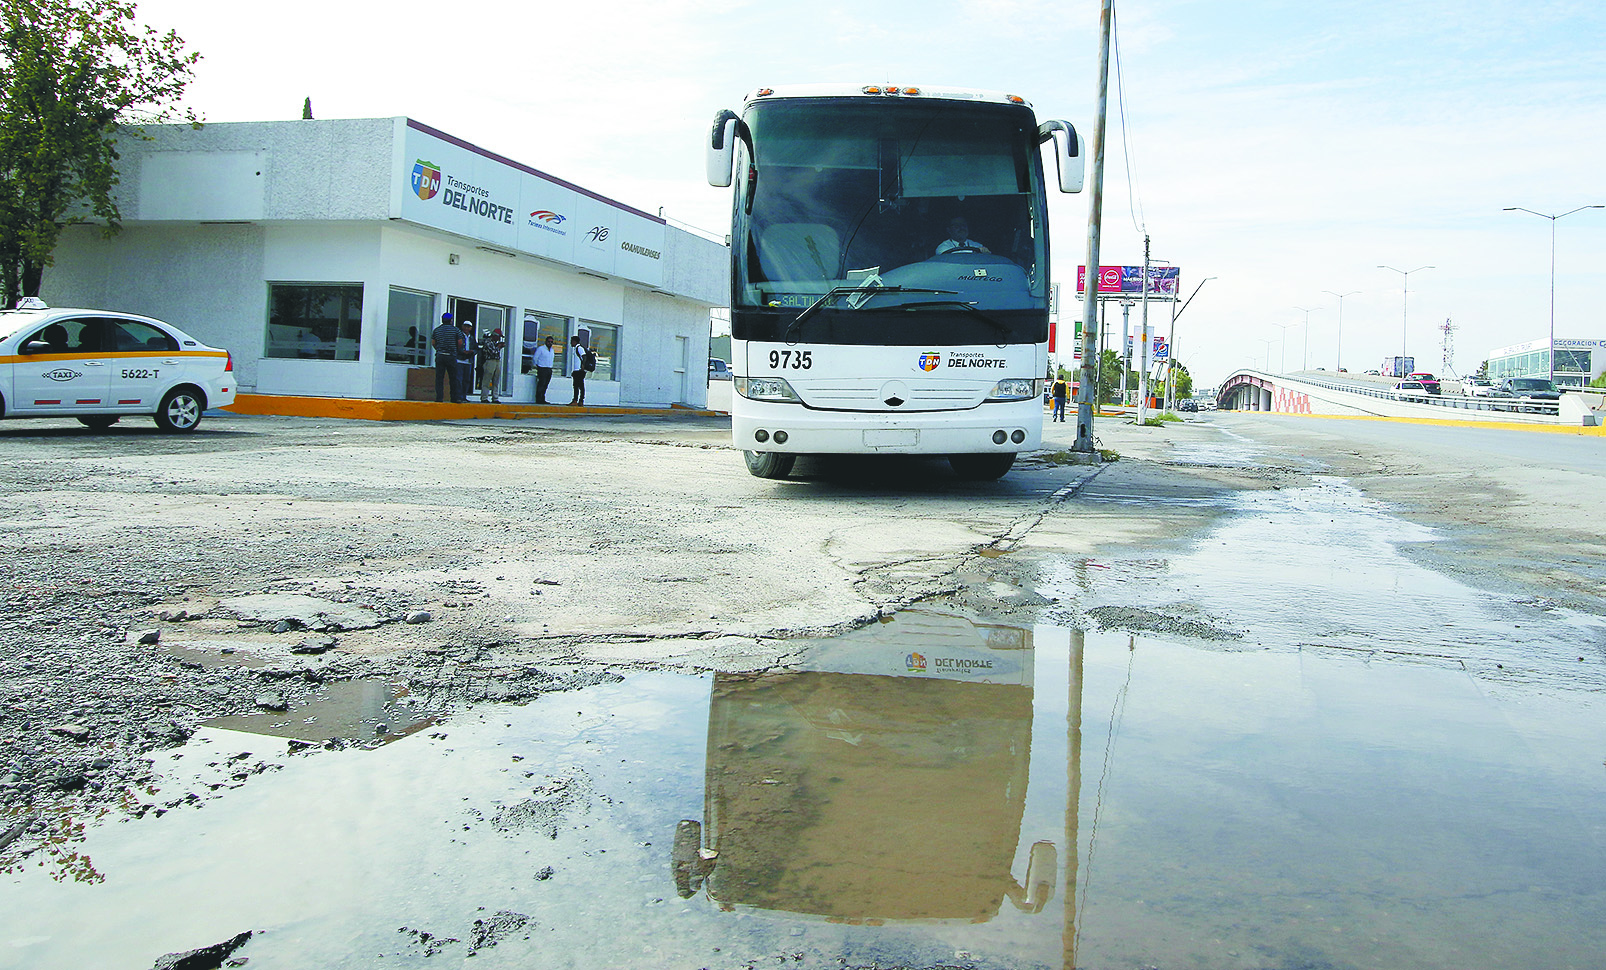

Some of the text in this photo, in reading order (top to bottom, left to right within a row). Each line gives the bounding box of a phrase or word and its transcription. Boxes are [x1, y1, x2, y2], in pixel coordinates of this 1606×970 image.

[412, 171, 440, 193] TDN
[446, 174, 490, 198] Transportes
[769, 350, 813, 370] 9735
[949, 351, 984, 359] Transportes
[919, 357, 940, 367] TDN
[53, 371, 73, 379] TAXI
[121, 369, 160, 379] 5622-T
